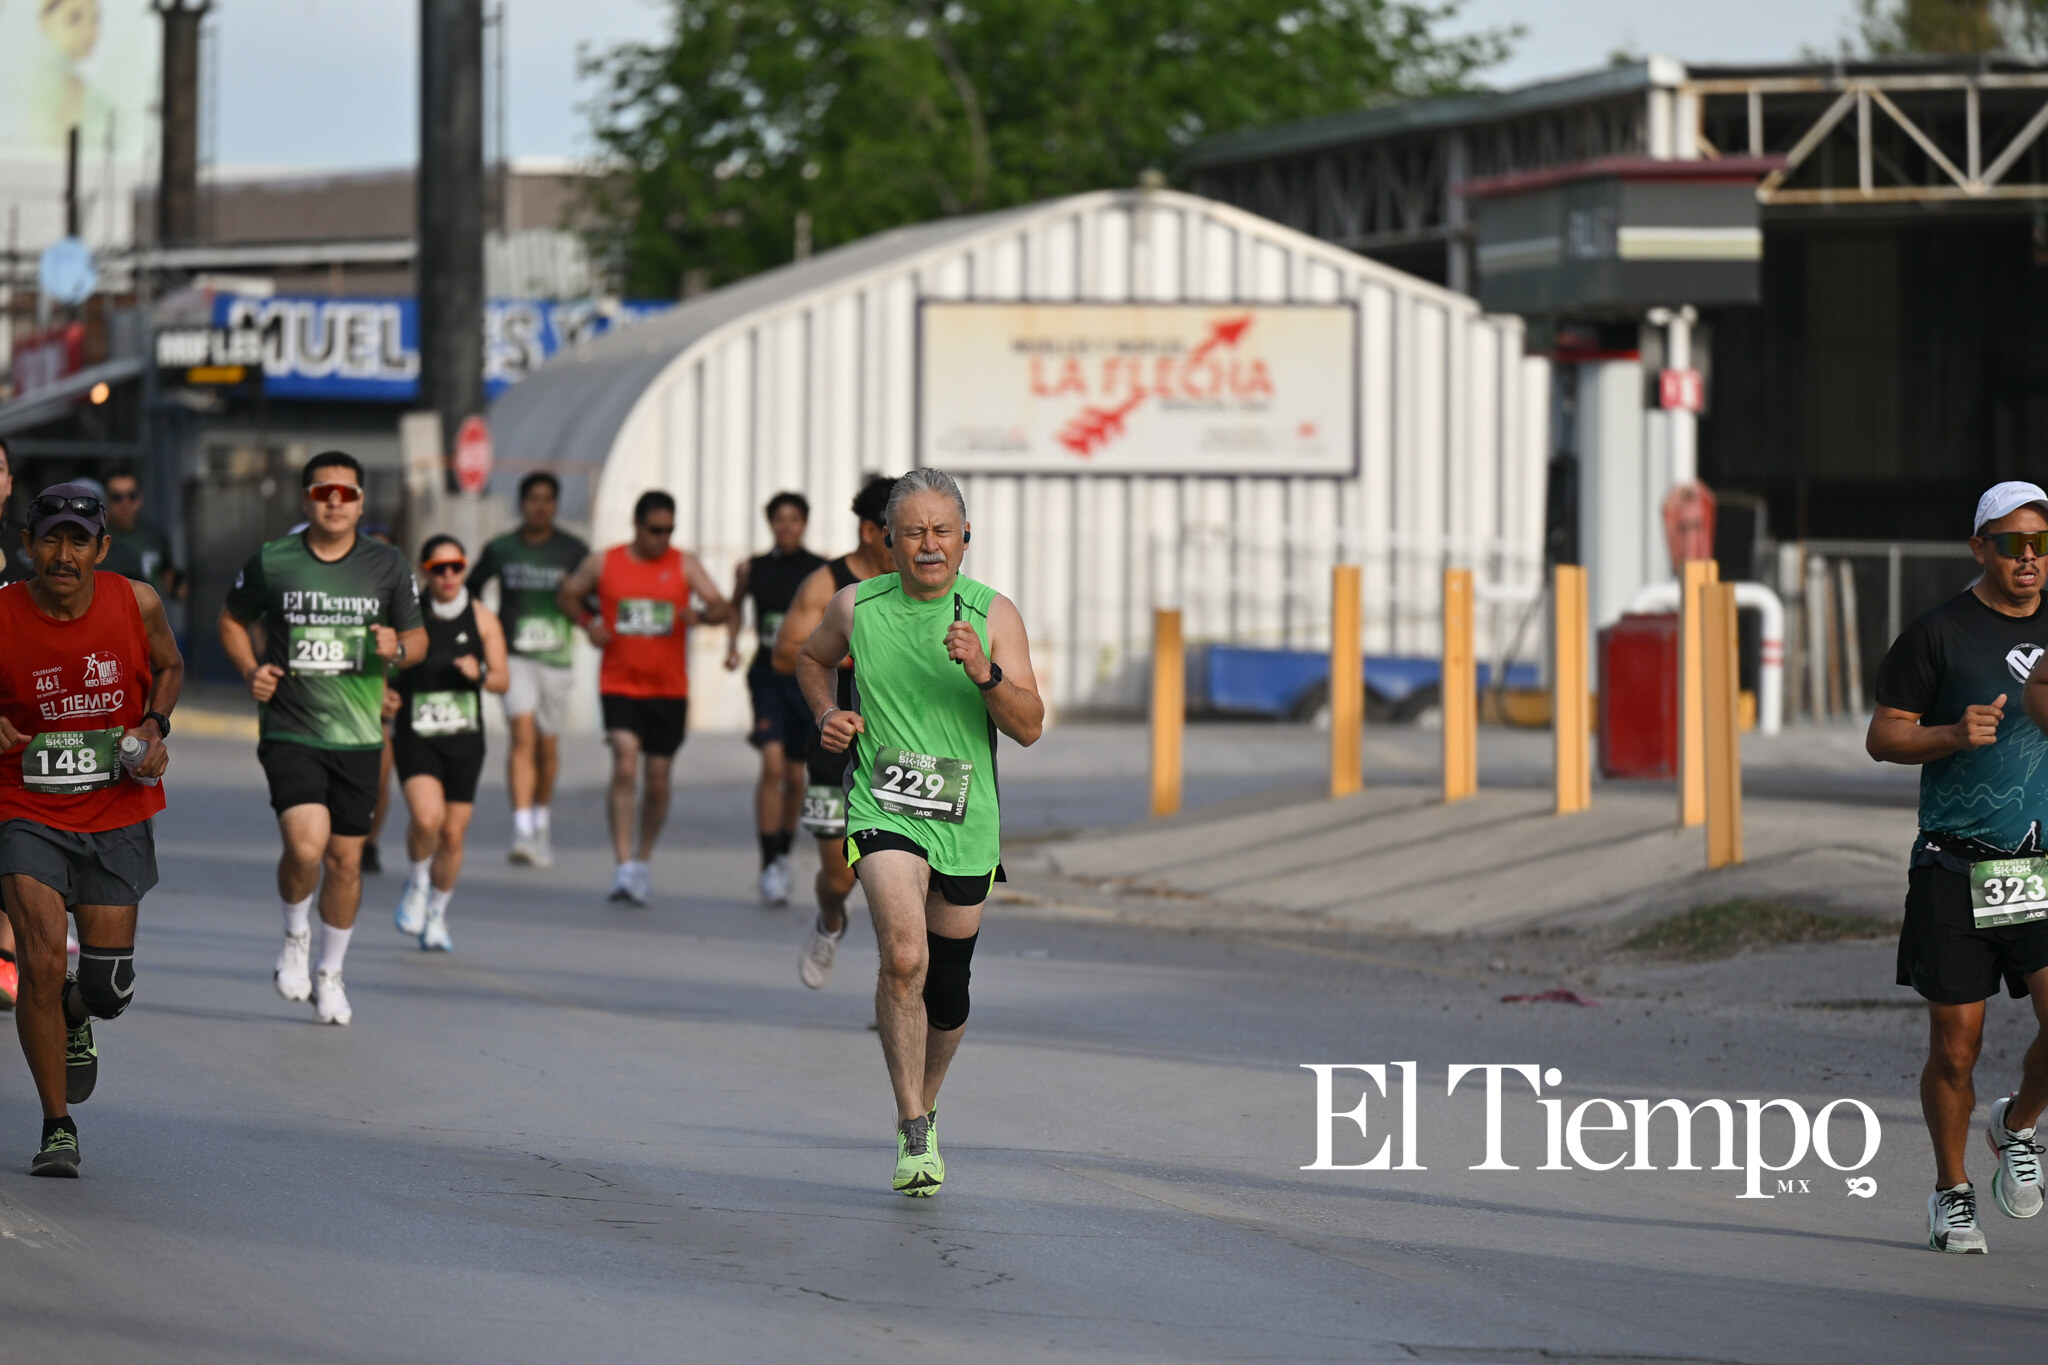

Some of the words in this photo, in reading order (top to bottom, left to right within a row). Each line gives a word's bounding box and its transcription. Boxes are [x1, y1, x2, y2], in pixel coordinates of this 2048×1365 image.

[1028, 356, 1087, 398] LA
[283, 591, 303, 611] El
[304, 591, 380, 616] Tiempo
[308, 612, 365, 626] todos
[296, 640, 345, 662] 208
[32, 666, 62, 677] CELEBRANDO
[35, 675, 55, 692] 46
[61, 690, 124, 713] TIEMPO
[45, 738, 85, 747] 5K-10K
[36, 748, 97, 775] 148
[898, 755, 937, 770] 5K-10K
[899, 750, 938, 763] CARRERA
[960, 763, 973, 771] 229
[882, 765, 945, 799] 229
[954, 774, 970, 817] MEDALLA
[804, 798, 839, 819] 587
[1993, 859, 2031, 868] CARRERA
[1984, 875, 2047, 906] 323
